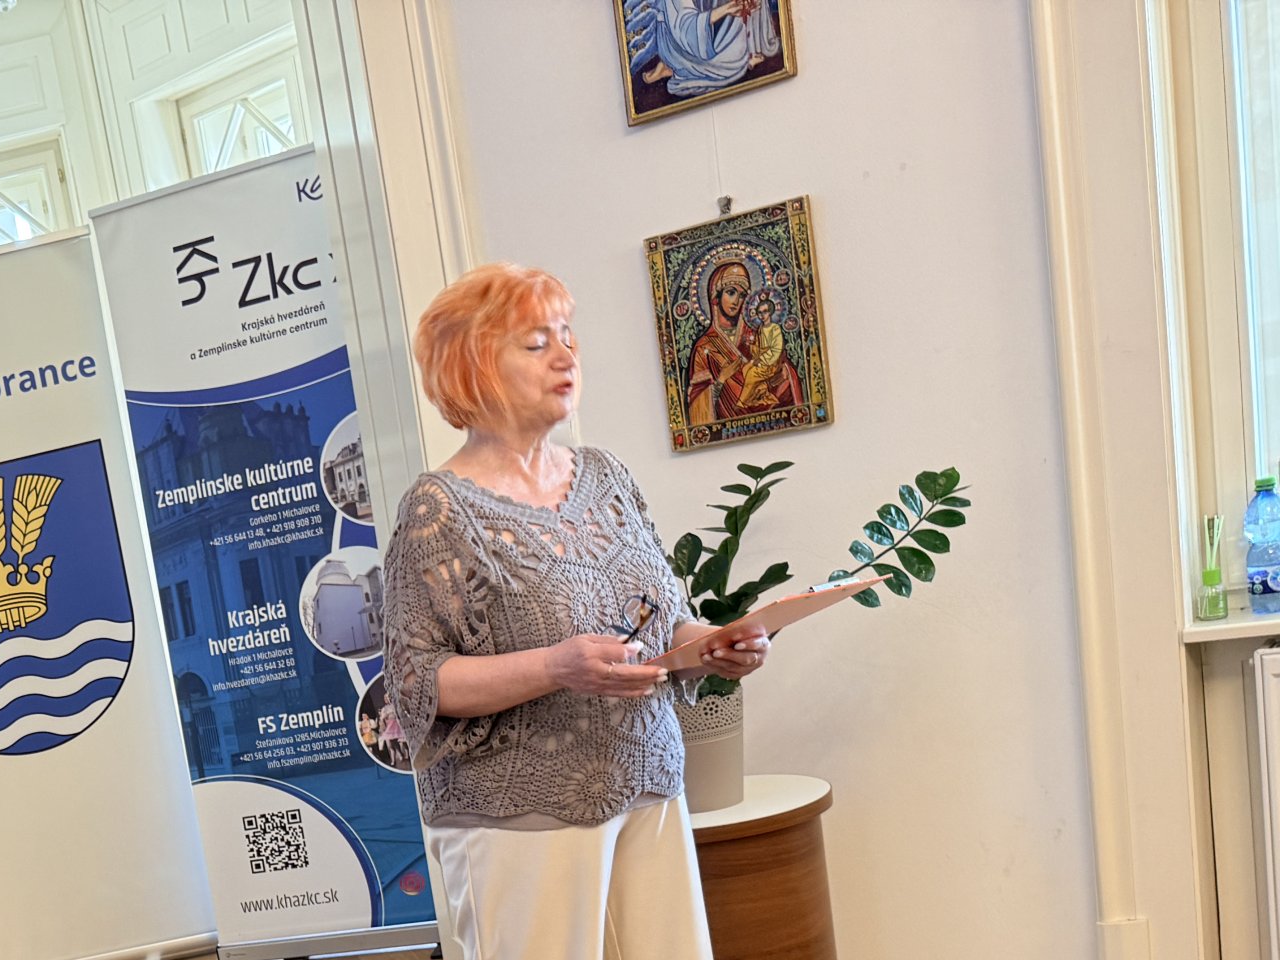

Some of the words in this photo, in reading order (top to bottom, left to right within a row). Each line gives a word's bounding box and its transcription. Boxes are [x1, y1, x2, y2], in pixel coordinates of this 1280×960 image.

[241, 314, 276, 332] Krajská
[277, 301, 326, 322] hvezdáreň
[190, 352, 196, 360] a
[198, 339, 248, 358] Zemplínske
[249, 328, 287, 344] kultúrne
[289, 317, 328, 334] centrum
[155, 473, 243, 509] Zemplínske
[245, 456, 314, 488] kultúrne
[251, 482, 318, 511] centrum
[282, 503, 320, 519] Michalovce
[210, 537, 224, 546] +421
[224, 534, 234, 544] 56
[234, 531, 247, 542] 644
[247, 530, 254, 539] 13
[283, 521, 295, 531] 918
[296, 518, 309, 528] 908
[310, 515, 322, 525] 310
[248, 526, 324, 550] info.khazkc@khazkc.sk
[227, 599, 287, 629] Krajská
[208, 623, 291, 656] hvezdáreň
[256, 647, 294, 661] Michalovce
[240, 666, 254, 674] +421
[254, 664, 264, 673] 56
[264, 661, 277, 671] 644
[277, 660, 285, 669] 32
[285, 658, 296, 667] 60
[257, 715, 277, 734] FS
[278, 704, 344, 731] Zemplín
[240, 753, 254, 762] +421
[254, 751, 264, 760] 56
[264, 750, 272, 759] 64
[273, 747, 285, 758] 256
[296, 743, 311, 752] +421
[311, 741, 323, 751] 907
[324, 739, 337, 749] 936
[338, 737, 349, 746] 313
[240, 887, 339, 913] www.khazkc.sk
